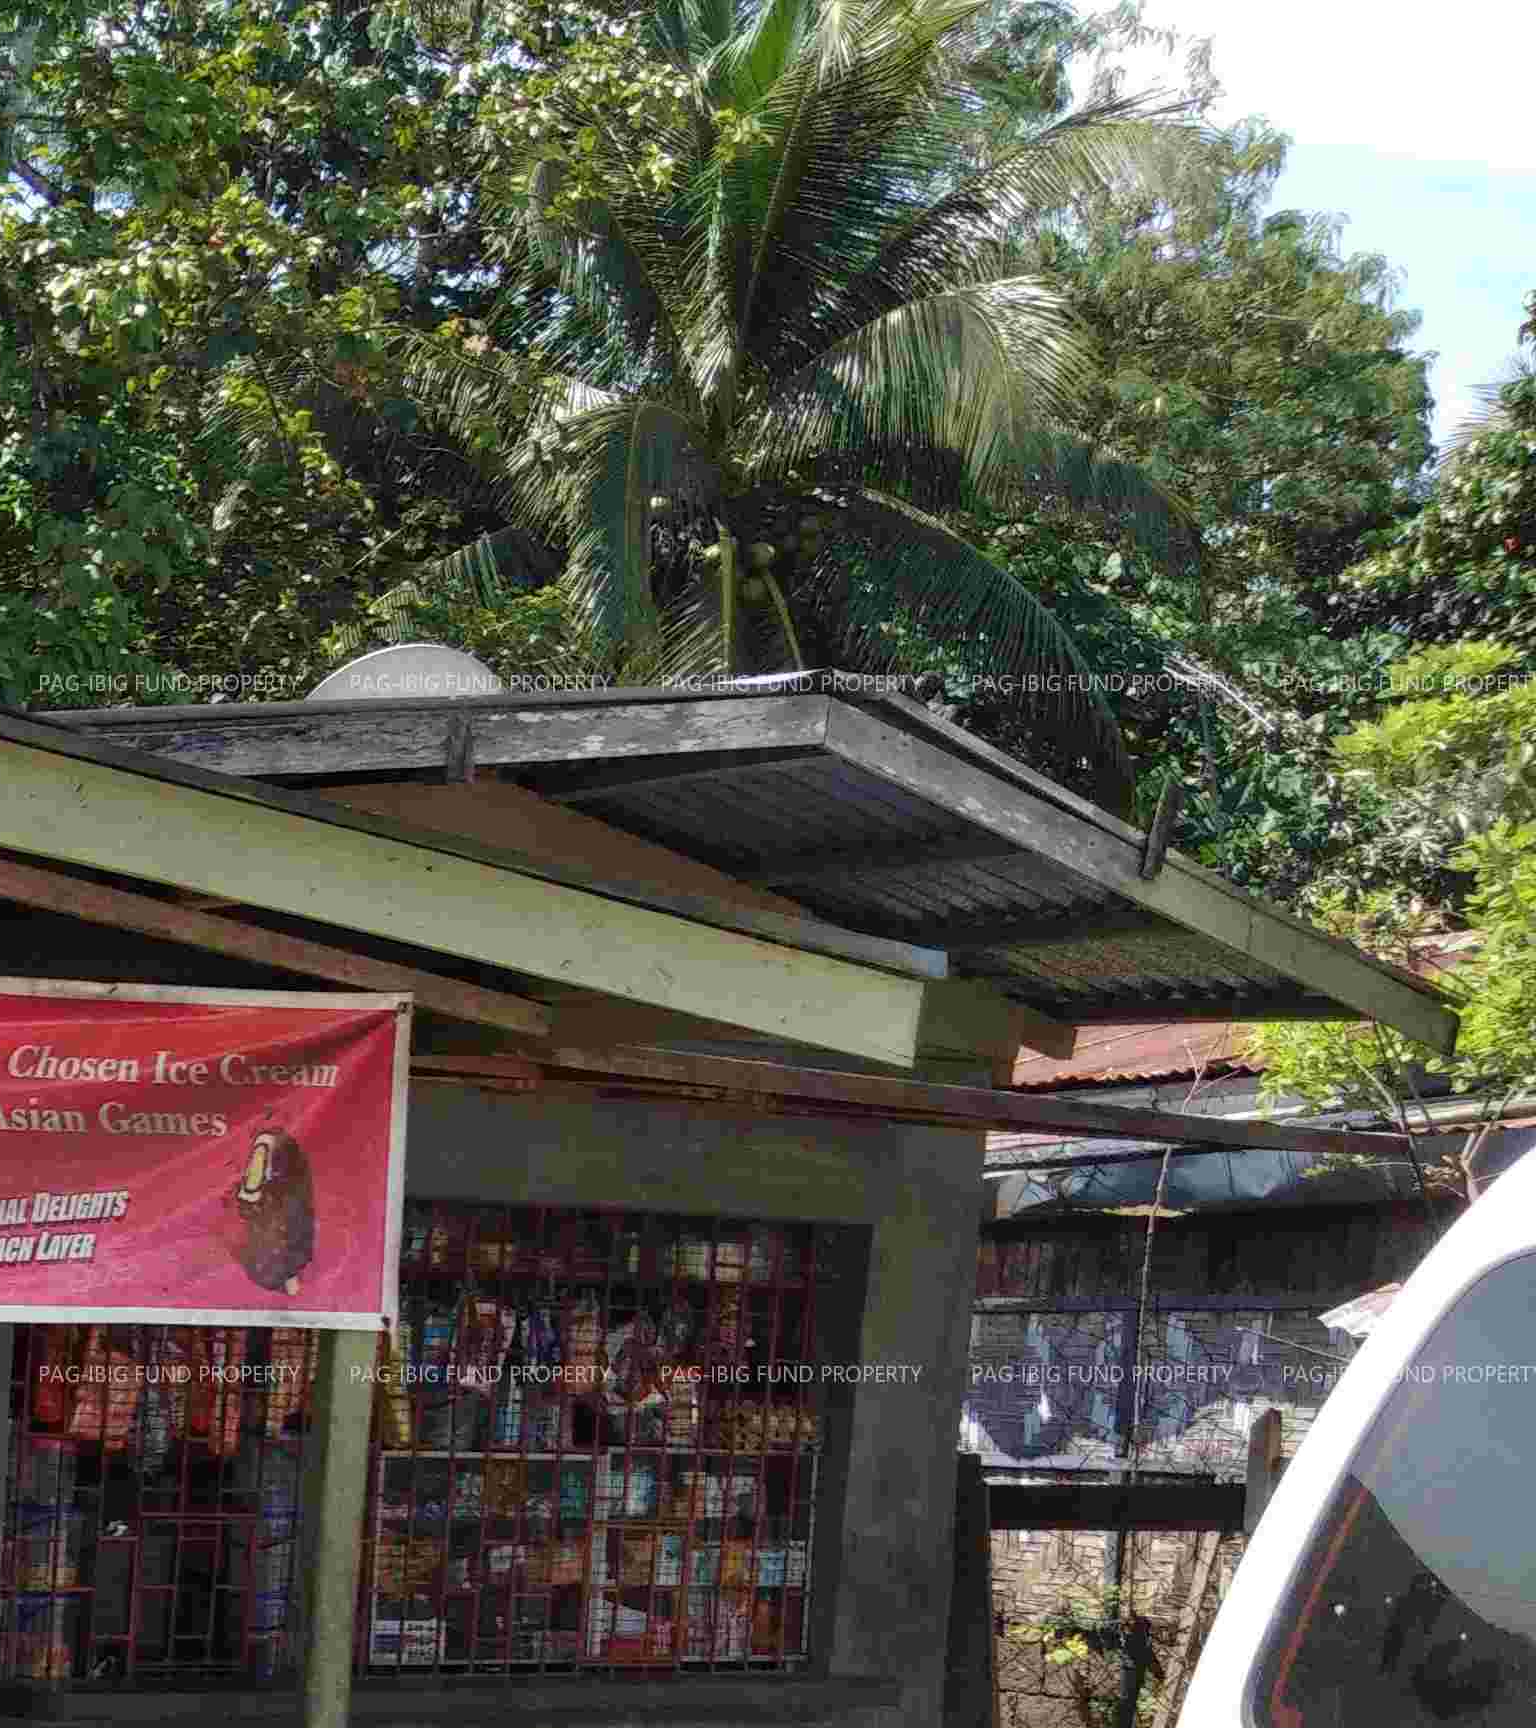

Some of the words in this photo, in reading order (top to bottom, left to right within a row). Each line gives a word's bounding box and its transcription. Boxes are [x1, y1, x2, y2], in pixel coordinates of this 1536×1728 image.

[8, 1044, 140, 1083] Chosen
[151, 1050, 208, 1085] Ice
[220, 1054, 338, 1087] Cream
[98, 1101, 229, 1137] Games
